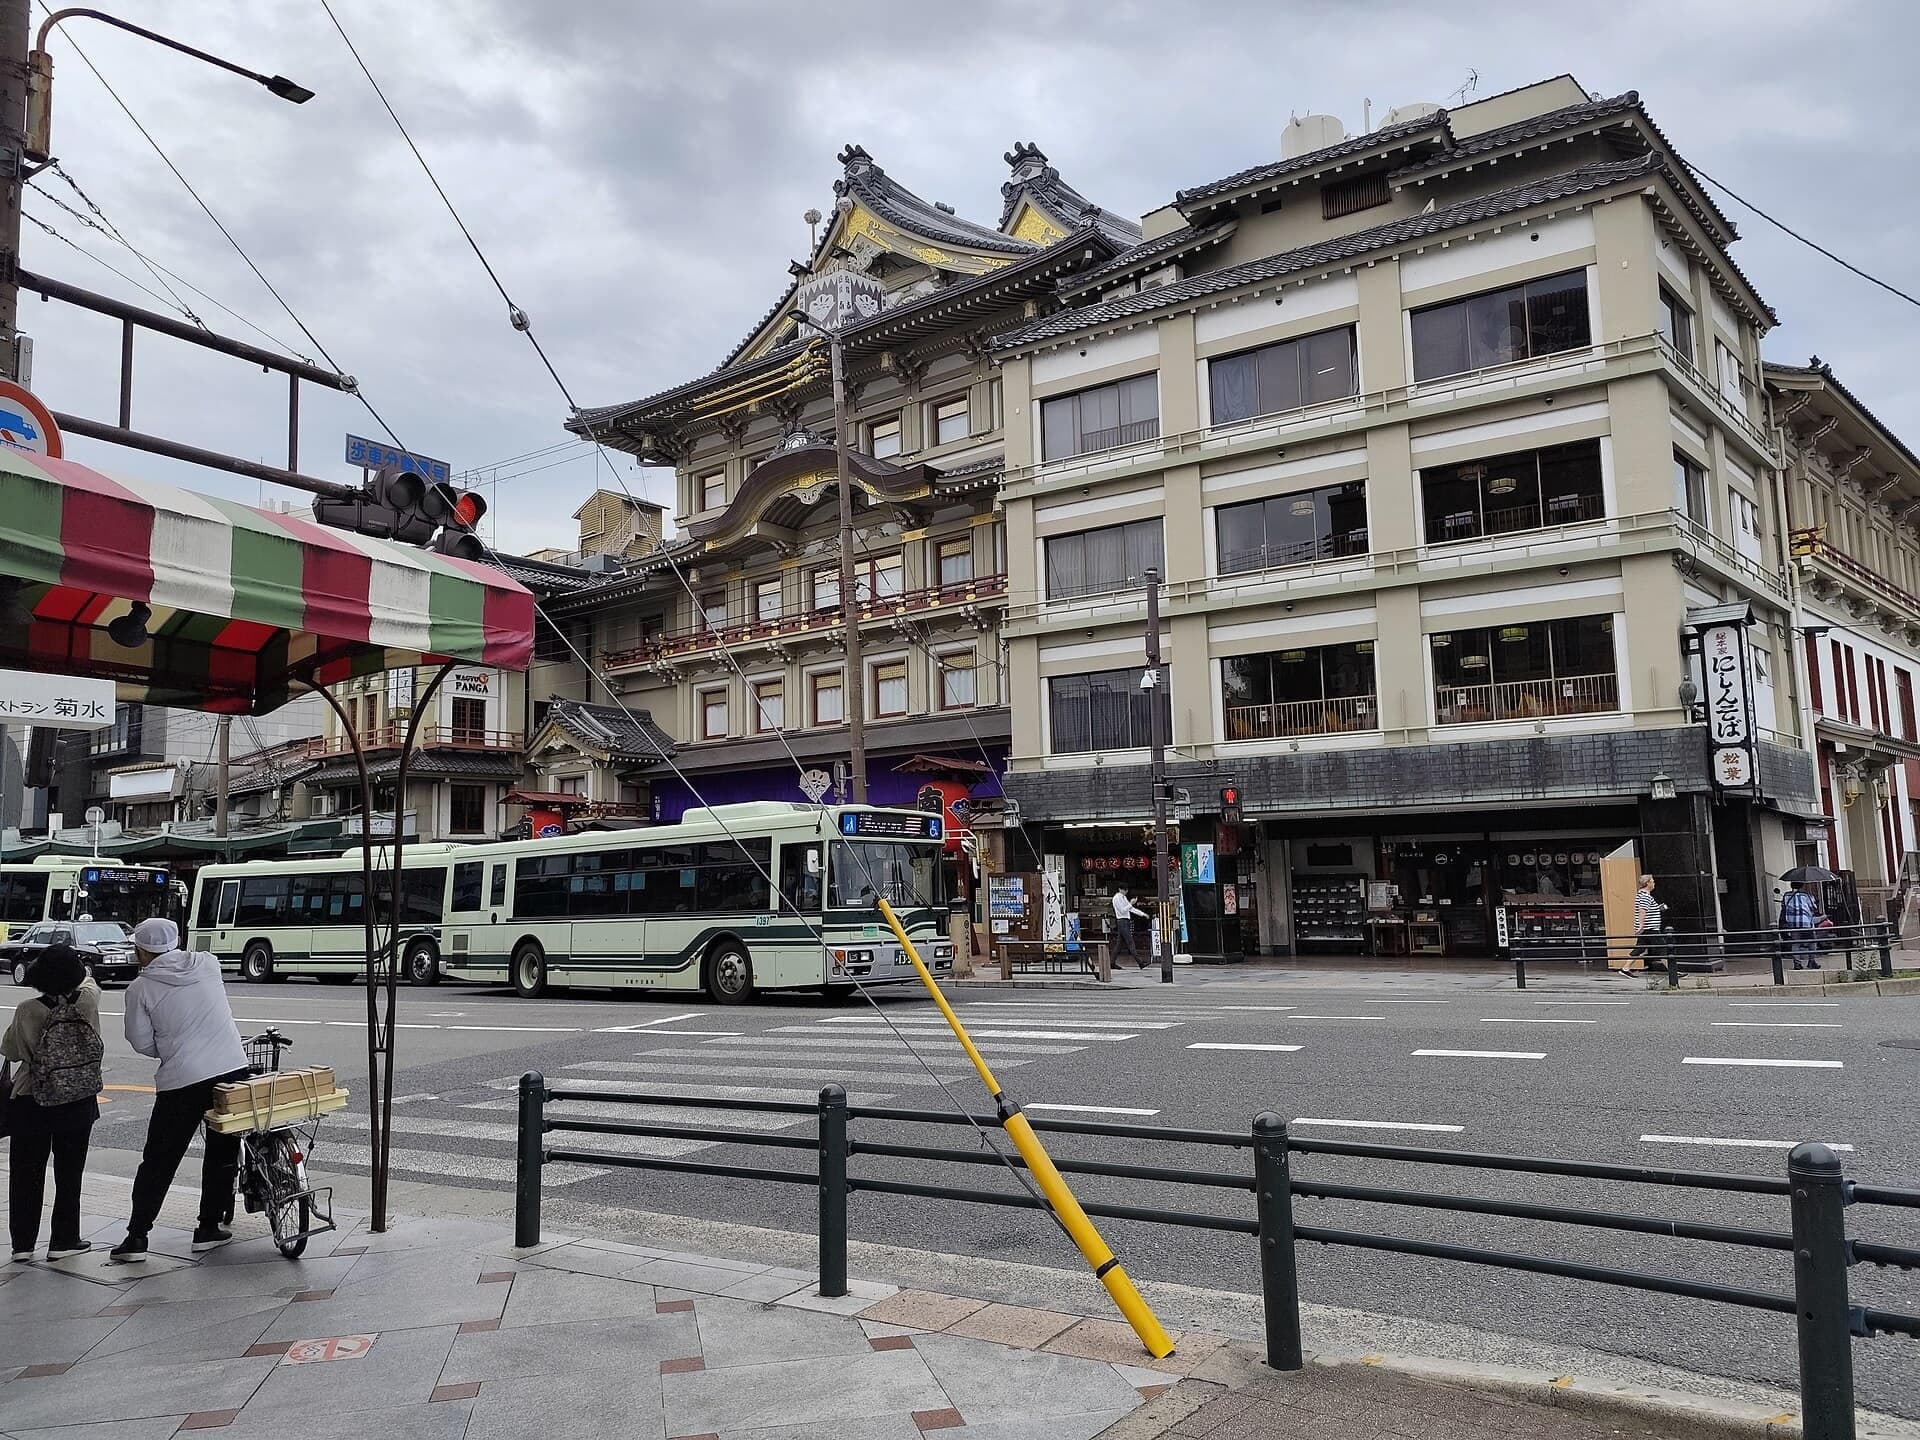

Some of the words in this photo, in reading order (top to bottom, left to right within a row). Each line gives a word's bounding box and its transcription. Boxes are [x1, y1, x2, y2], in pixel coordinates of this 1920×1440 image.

[455, 681, 489, 693] PANGA
[1712, 655, 1742, 739] にしんそば
[54, 697, 105, 718] 菊水
[1722, 752, 1742, 780] 松葉
